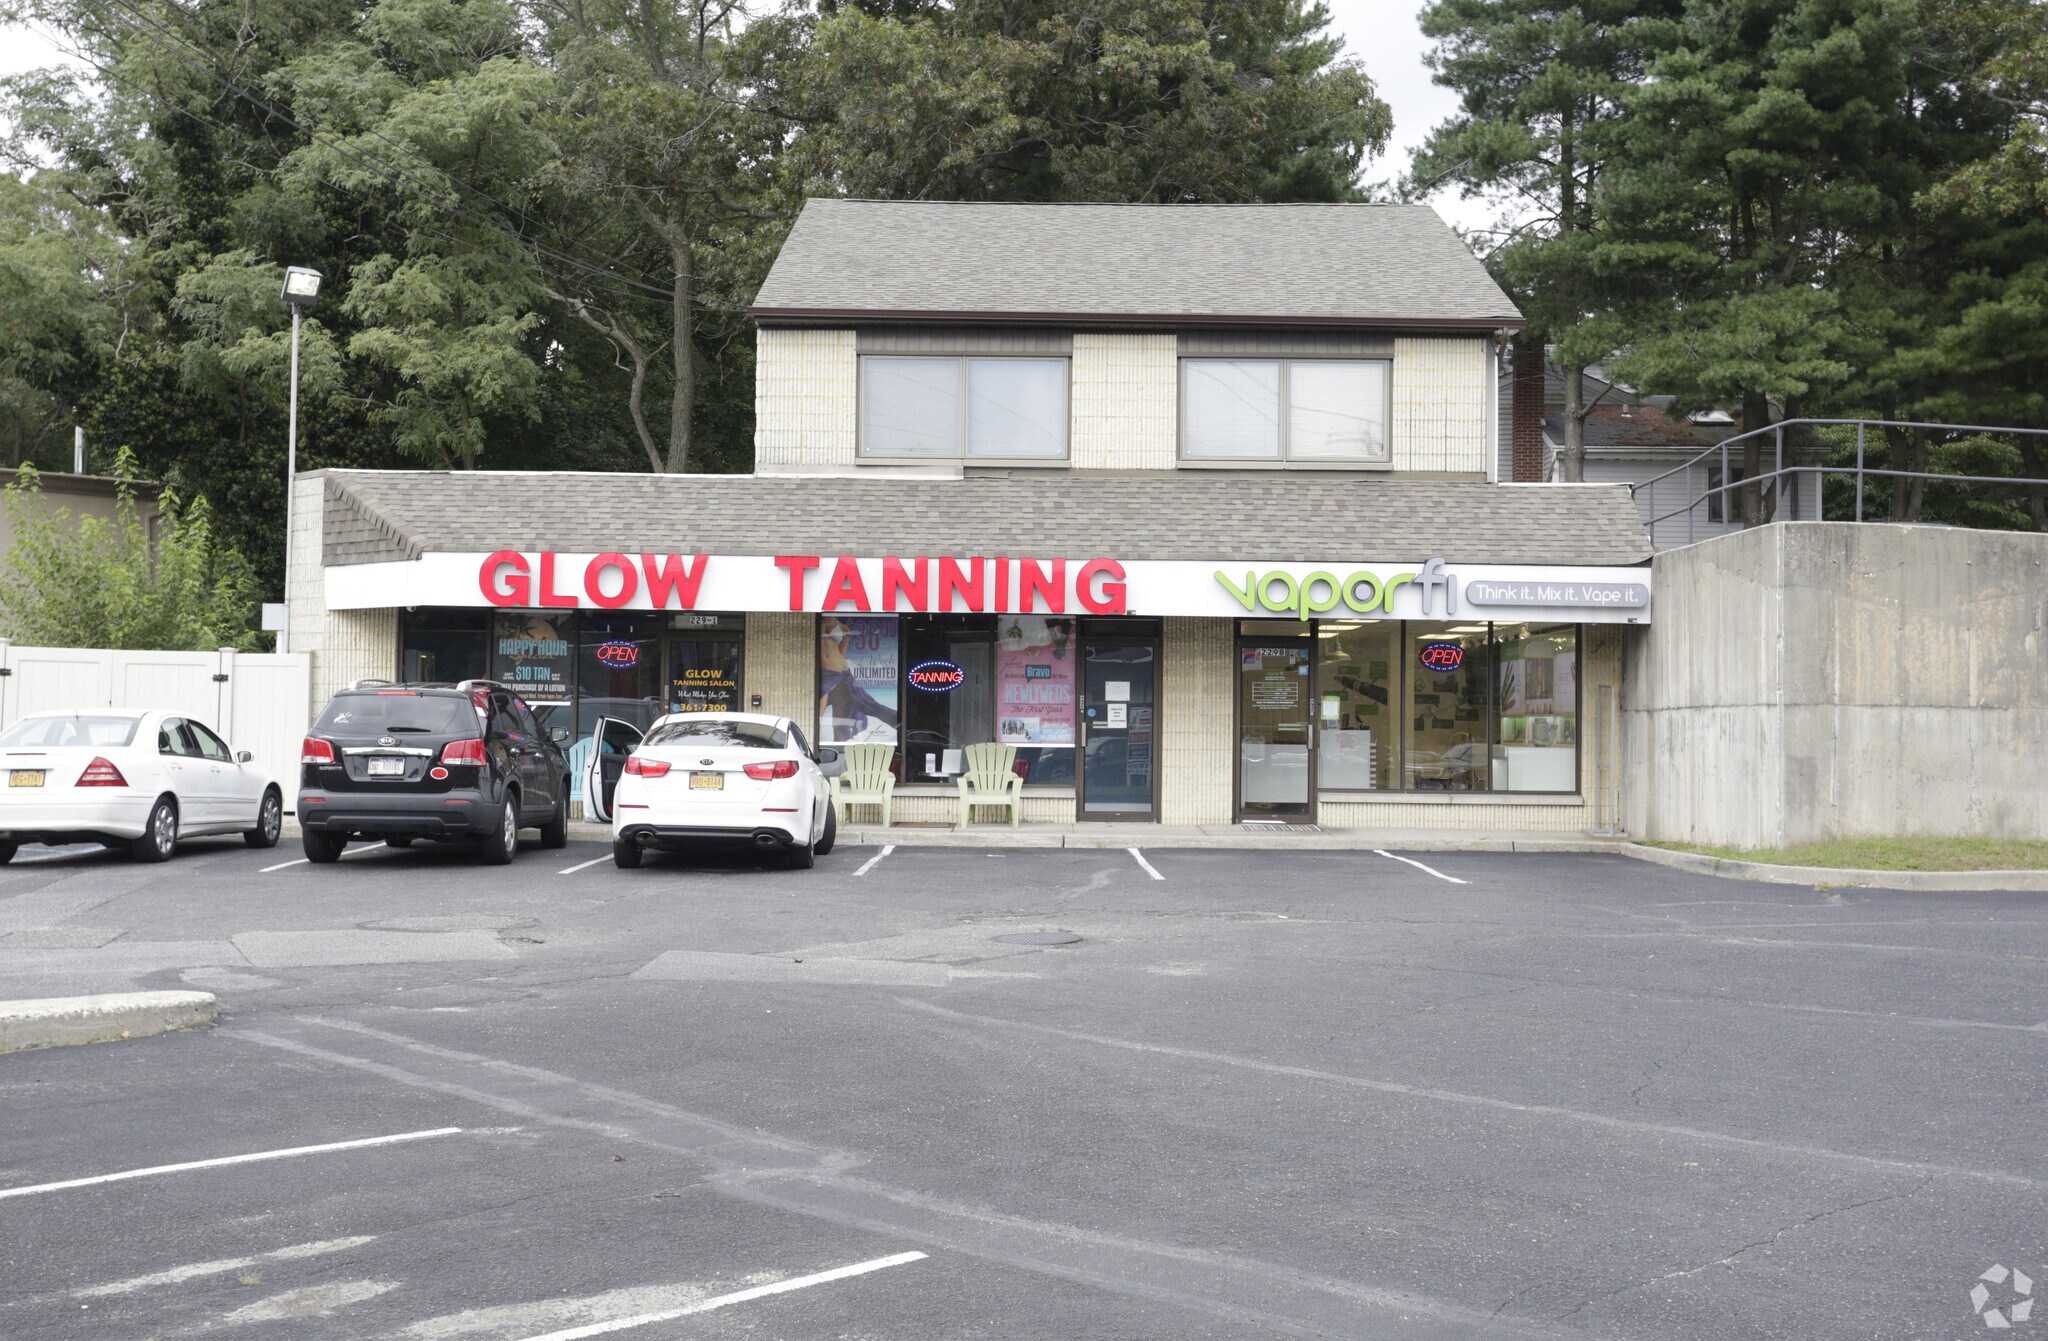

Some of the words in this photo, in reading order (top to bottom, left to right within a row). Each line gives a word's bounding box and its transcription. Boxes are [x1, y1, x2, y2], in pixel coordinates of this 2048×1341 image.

[479, 550, 709, 609] GLOW
[775, 555, 1127, 614] TANNING
[1214, 557, 1457, 621] vaporfi
[1476, 585, 1517, 600] Think
[1520, 586, 1534, 600] it.
[1537, 586, 1562, 600] Mix
[1565, 587, 1578, 601] it.
[1582, 587, 1621, 604] Vape
[1625, 588, 1638, 602] it.
[690, 616, 716, 624] 229-1
[499, 639, 534, 655] HAPPY
[538, 640, 568, 656] HOUR
[597, 645, 638, 661] OPEN
[1422, 649, 1463, 664] OPEN
[515, 666, 531, 681] $10
[534, 667, 550, 680] TAN
[685, 669, 722, 678] GLOW
[853, 667, 896, 679] UNLIMITED
[912, 671, 962, 683] TANNING
[1027, 666, 1050, 677] Bravo
[1005, 684, 1071, 703] NEWLYWEDS
[680, 703, 727, 712] 361-7300
